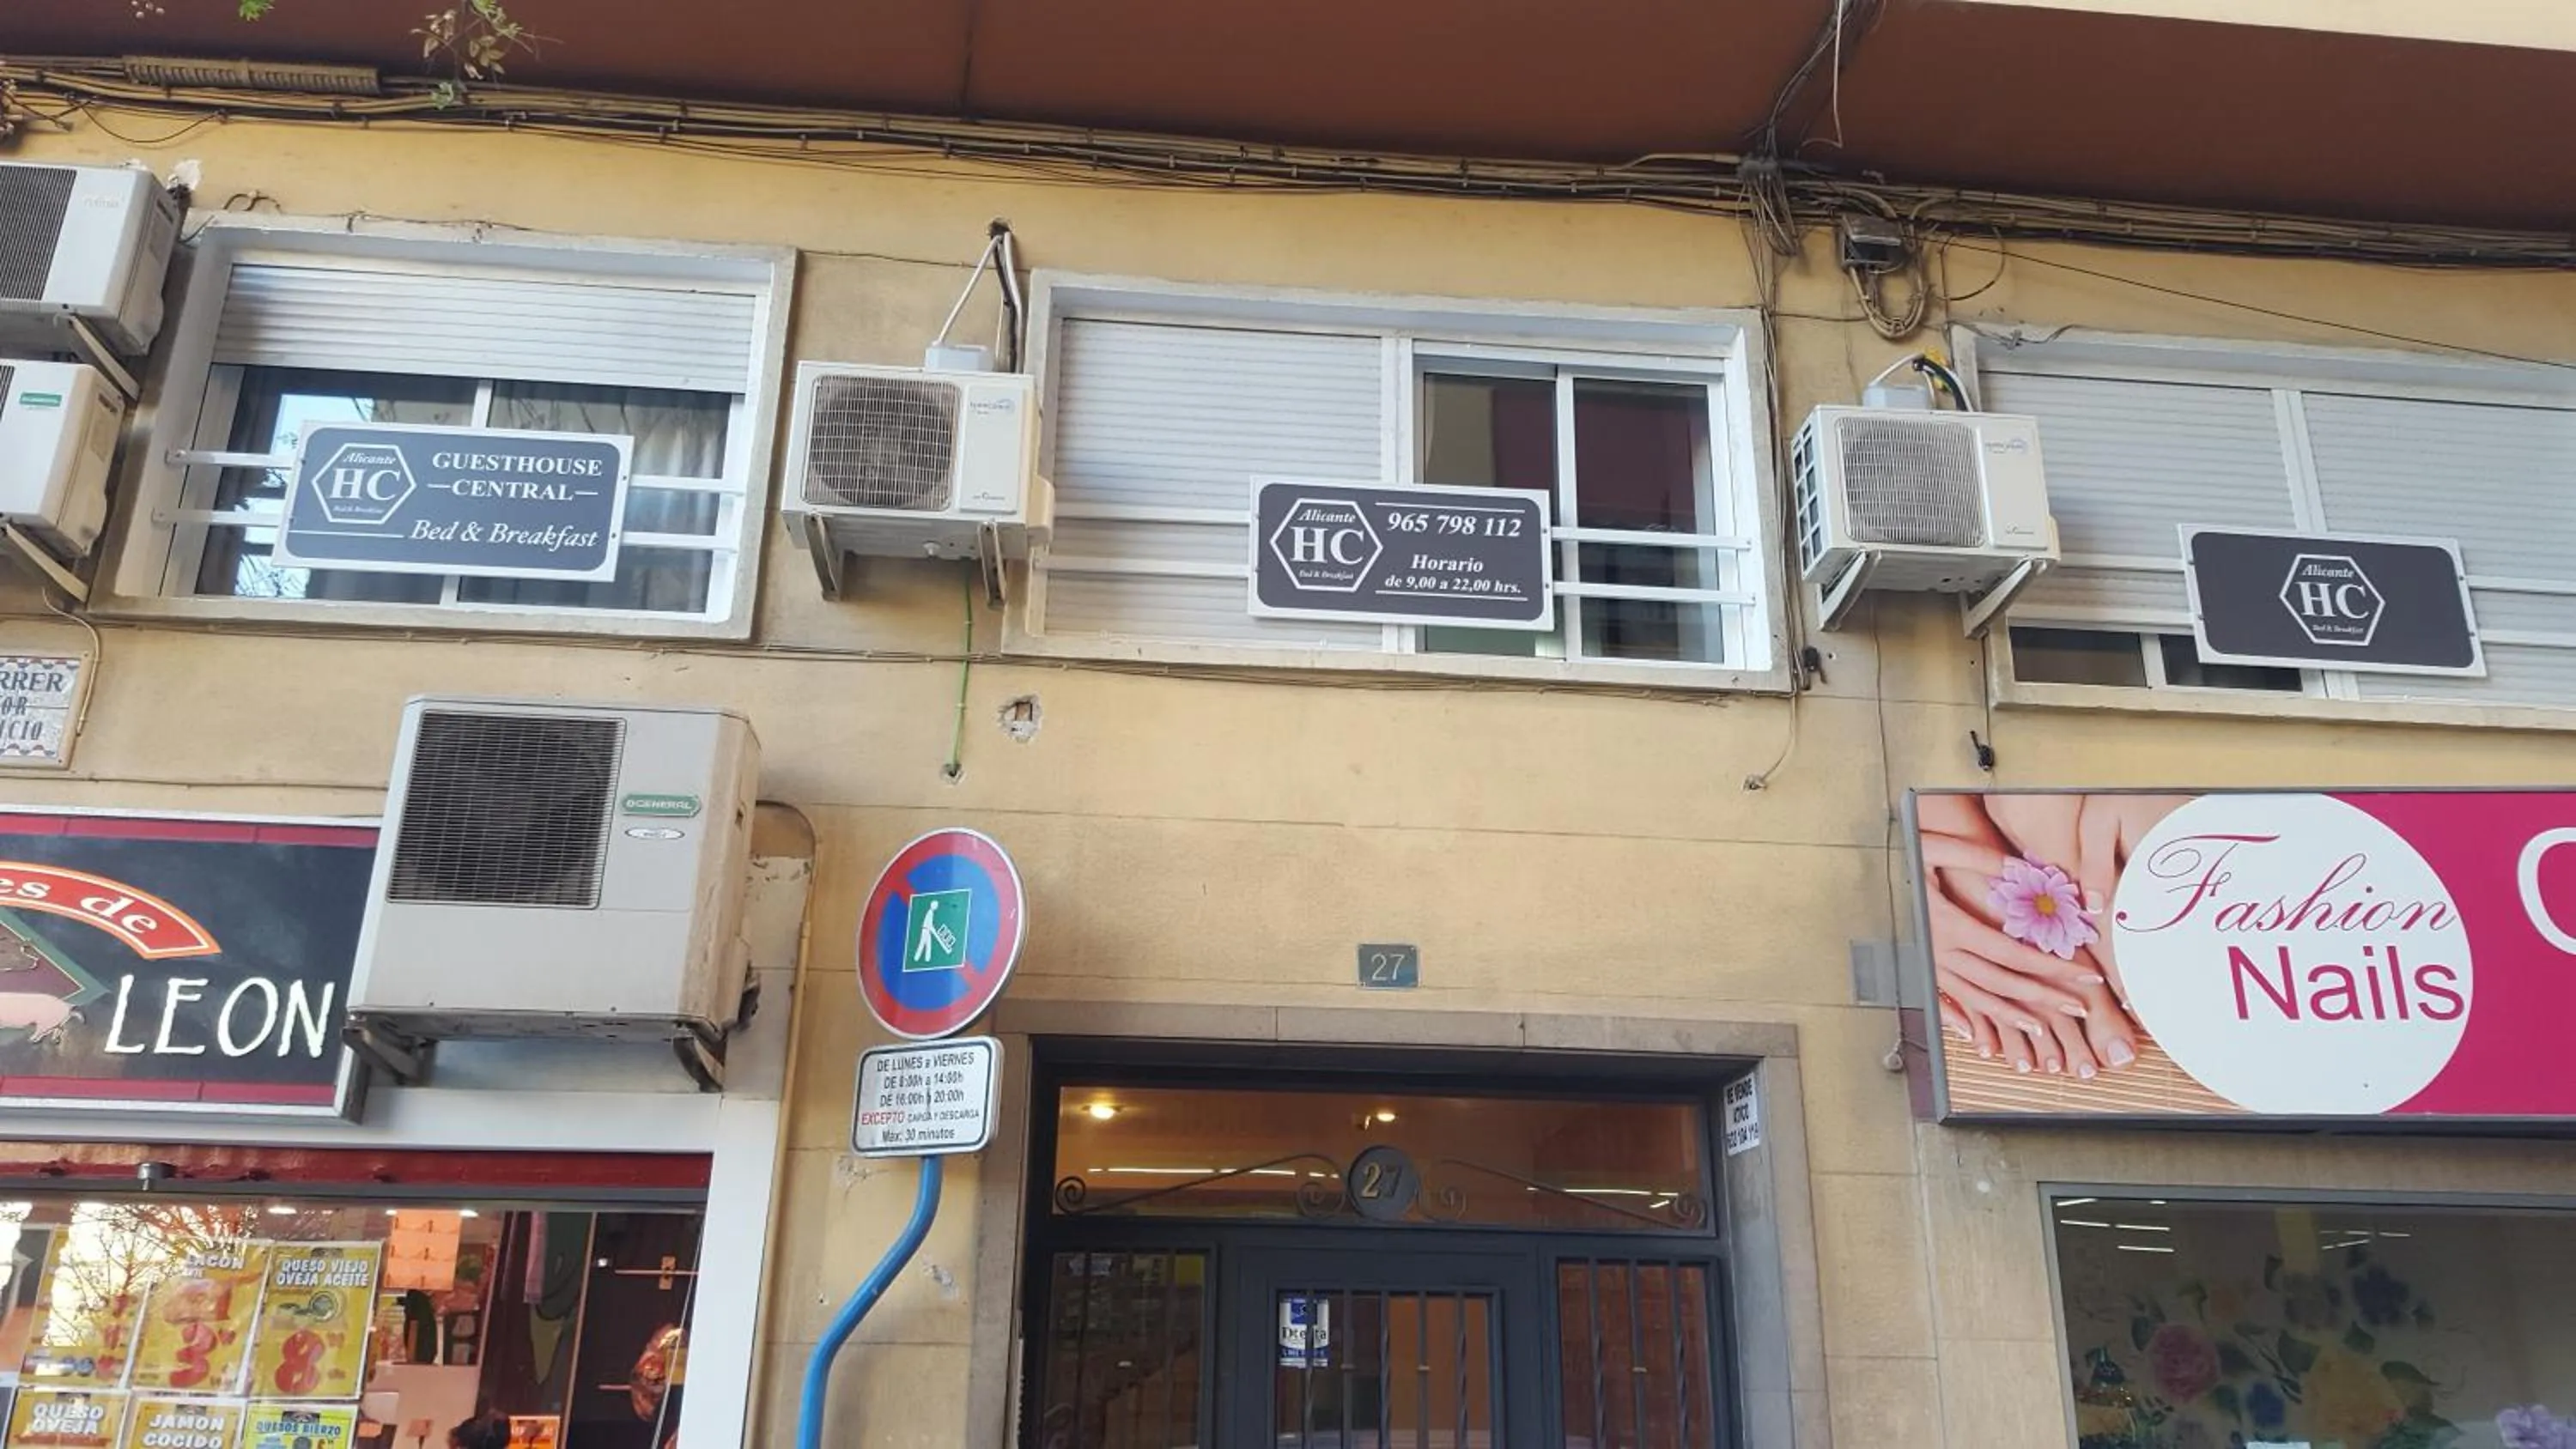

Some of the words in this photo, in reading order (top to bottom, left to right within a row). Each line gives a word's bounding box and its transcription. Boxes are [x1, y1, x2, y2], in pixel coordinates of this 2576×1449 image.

[343, 451, 396, 465] Alicante
[432, 452, 602, 476] GUESTHOUSE
[329, 468, 401, 501] HC
[452, 479, 573, 501] CENTRAL
[1298, 508, 1356, 524] Alicante
[1388, 512, 1429, 533] 965
[1436, 514, 1476, 536] 798
[1484, 518, 1522, 537] 112
[410, 519, 457, 541] Bed
[460, 522, 483, 543] &
[488, 521, 598, 552] Breakfast
[1290, 526, 1364, 565] HC
[1411, 555, 1484, 573] Horario
[2302, 564, 2354, 578] Alicante
[1385, 575, 1401, 588] de
[1406, 576, 1437, 591] 9,00
[1439, 580, 1448, 590] a
[1452, 578, 1491, 593] 22,00
[1494, 579, 1522, 594] hrs.
[2294, 581, 2369, 619] HC
[2115, 833, 2457, 933] Fashion
[80, 895, 157, 934] de
[1371, 953, 1405, 980] 27
[2227, 945, 2465, 1022] Nails
[104, 973, 335, 1058] LEON
[877, 1058, 890, 1072] DE
[892, 1057, 923, 1070] LUNES
[933, 1052, 975, 1067] VIERNES
[884, 1076, 896, 1089] DE
[879, 1094, 892, 1107] DE
[861, 1111, 904, 1125] EXCEPTO
[905, 1128, 916, 1141] 30
[918, 1127, 955, 1141] minutos
[282, 1259, 325, 1272] QUESO
[331, 1259, 368, 1273] VIEJO
[276, 1272, 319, 1286] OVEJA
[324, 1273, 369, 1287] ACEITE
[33, 1404, 104, 1420] QUESO
[31, 1418, 98, 1434] OVEJA
[149, 1414, 224, 1432] JAMON
[143, 1433, 222, 1449] COCIDO
